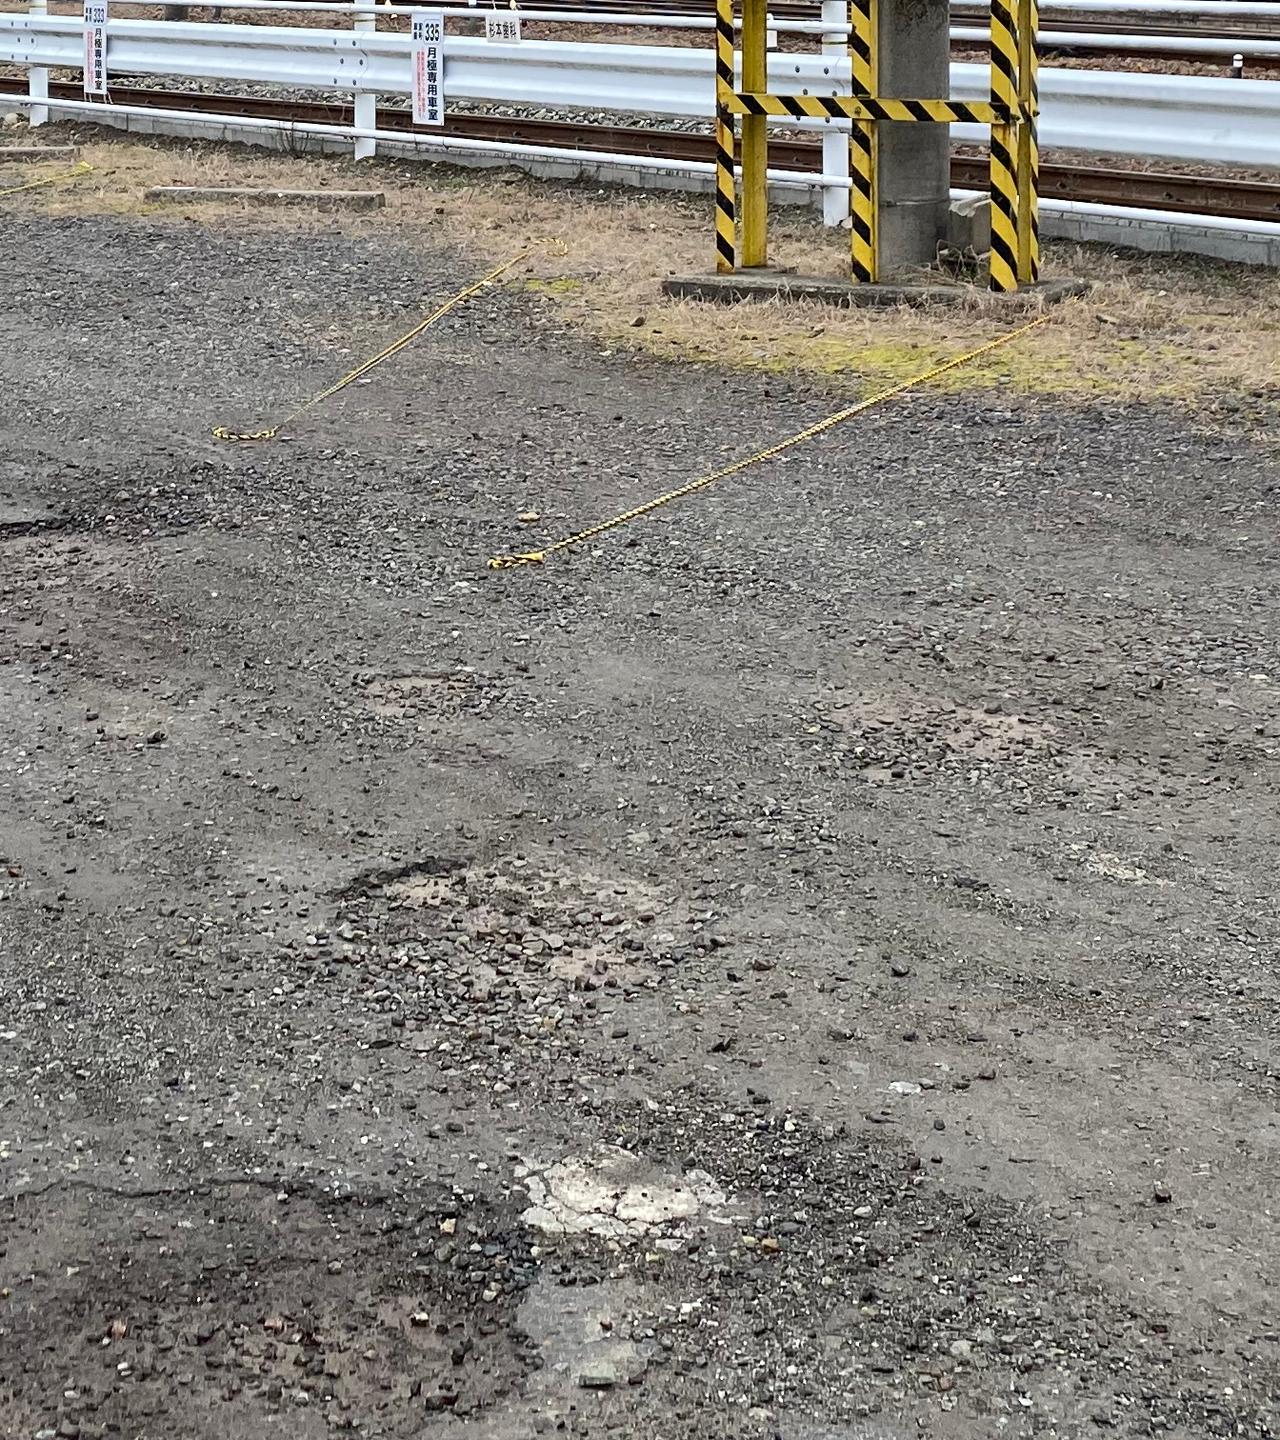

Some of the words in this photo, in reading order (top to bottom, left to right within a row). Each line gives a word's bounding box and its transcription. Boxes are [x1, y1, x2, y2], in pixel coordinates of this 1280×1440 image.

[425, 23, 440, 41] 335
[427, 46, 439, 121] 月極専用車室
